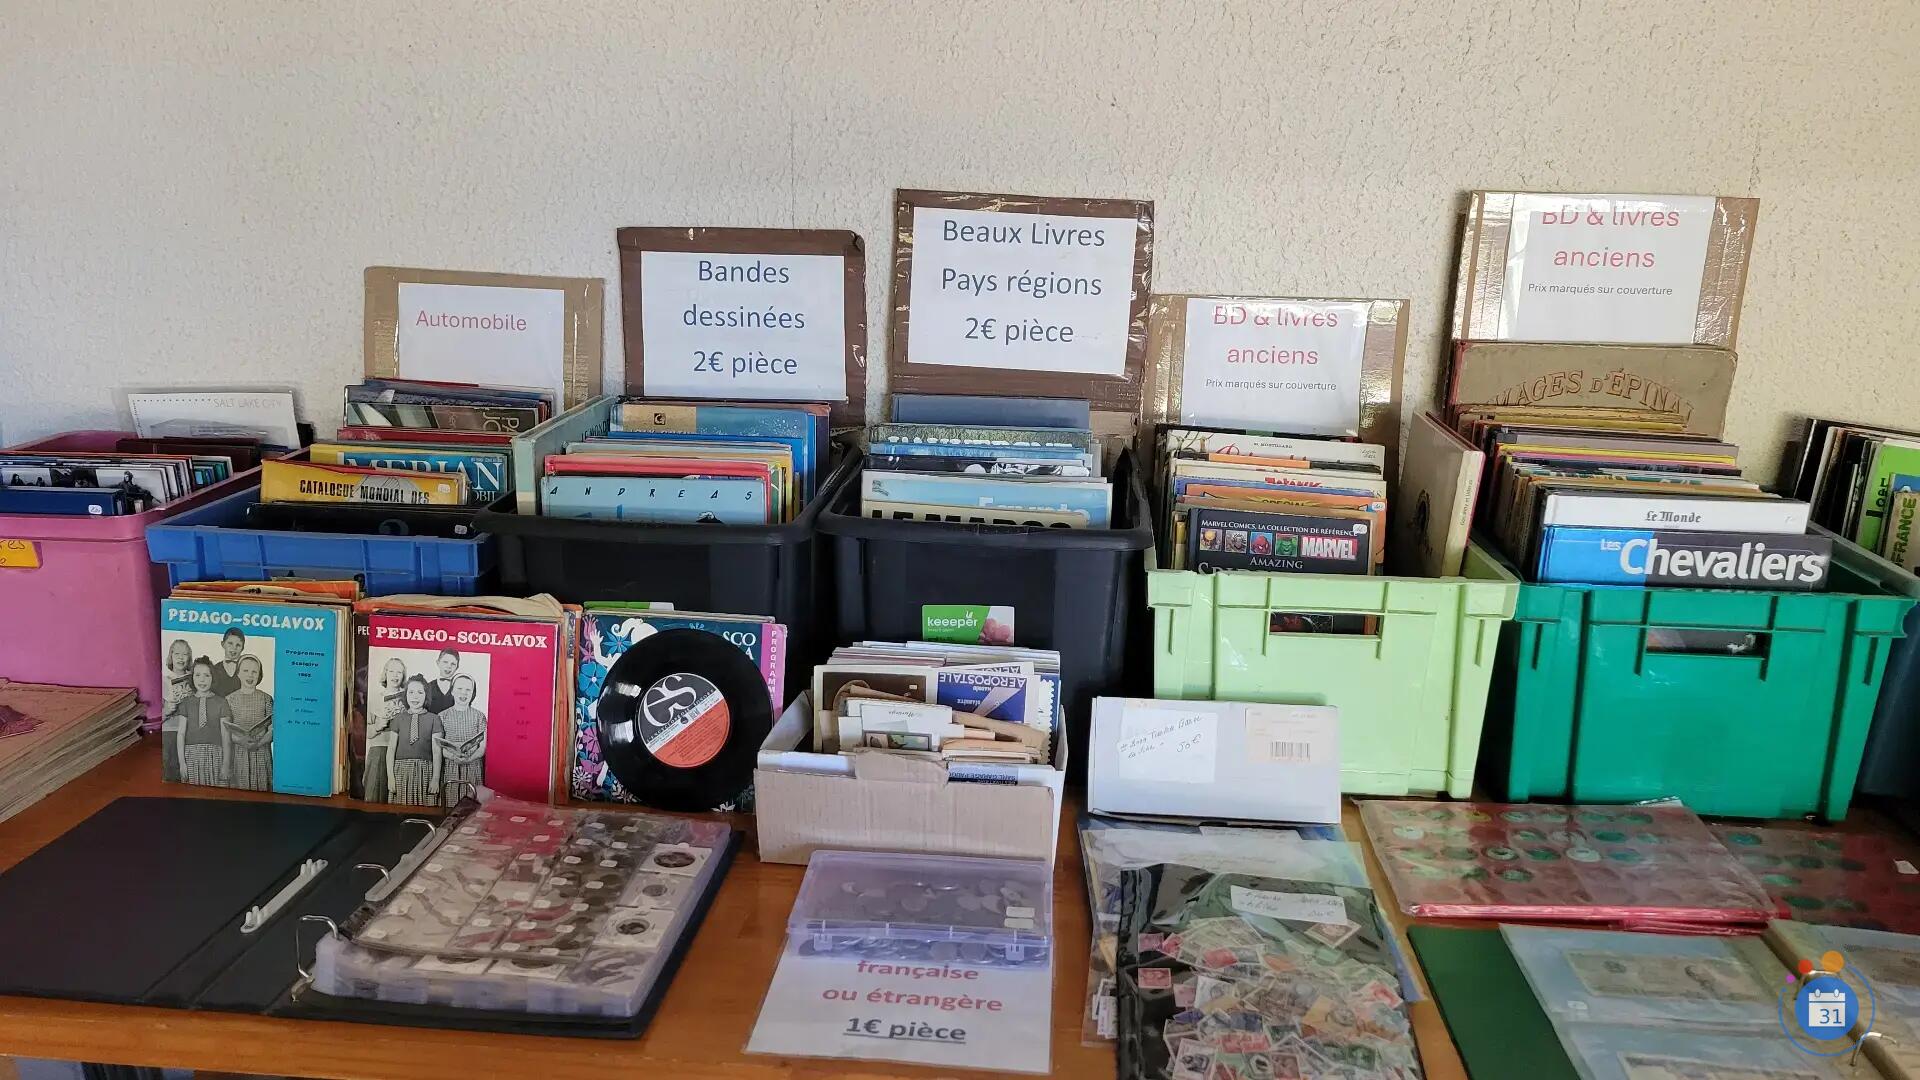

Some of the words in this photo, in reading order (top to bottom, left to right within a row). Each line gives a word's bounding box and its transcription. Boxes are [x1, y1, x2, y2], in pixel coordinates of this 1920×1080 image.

[1542, 205, 1579, 225] BD
[1587, 205, 1604, 225] &
[1612, 206, 1680, 227] livres
[943, 219, 1022, 244] Beaux
[1031, 222, 1105, 247] Livres
[1553, 247, 1655, 268] anciens
[698, 260, 790, 284] Bandes
[941, 268, 998, 297] Pays
[1006, 269, 1102, 299] régions
[1528, 283, 1547, 293] Prix
[1549, 284, 1595, 295] marqués
[1597, 286, 1614, 294] sur
[1616, 285, 1673, 296] couverture
[415, 310, 527, 331] Automobile
[683, 303, 806, 329] dessinées
[1213, 305, 1247, 326] BD
[1253, 311, 1270, 327] &
[1278, 307, 1339, 328] livres
[964, 317, 997, 340] 2€
[1005, 319, 1074, 346] pièce
[693, 351, 725, 373] 2€
[732, 351, 798, 378] pièce
[1227, 345, 1319, 365] anciens
[1205, 378, 1223, 388] Prix
[1225, 379, 1266, 392] marqués
[1285, 382, 1337, 391] couverture
[1493, 370, 1583, 407] MAGES
[300, 479, 354, 498] CATALOGUE
[360, 485, 405, 503] MONDIAL
[411, 491, 430, 504] DES
[1201, 519, 1227, 528] MARVEL
[1266, 524, 1308, 533] COLLECTION
[1645, 510, 1656, 522] Le
[1659, 511, 1702, 523] Monde
[1302, 537, 1356, 559] MARVEL
[1601, 537, 1621, 550] Les
[1250, 556, 1303, 569] AMAZING
[1619, 536, 1824, 583] Chevaliers
[168, 607, 325, 631] PEDAGO-SCOLAVOX
[927, 616, 978, 628] keeeper
[375, 626, 548, 649] PEDAGO-SCOLAVOX
[939, 672, 1028, 688] AEROPOSTALE
[857, 960, 980, 980] française
[822, 989, 858, 1001] ou
[866, 988, 1004, 1012] étrangère
[845, 1017, 883, 1034] 1€
[888, 1021, 967, 1041] pièce
